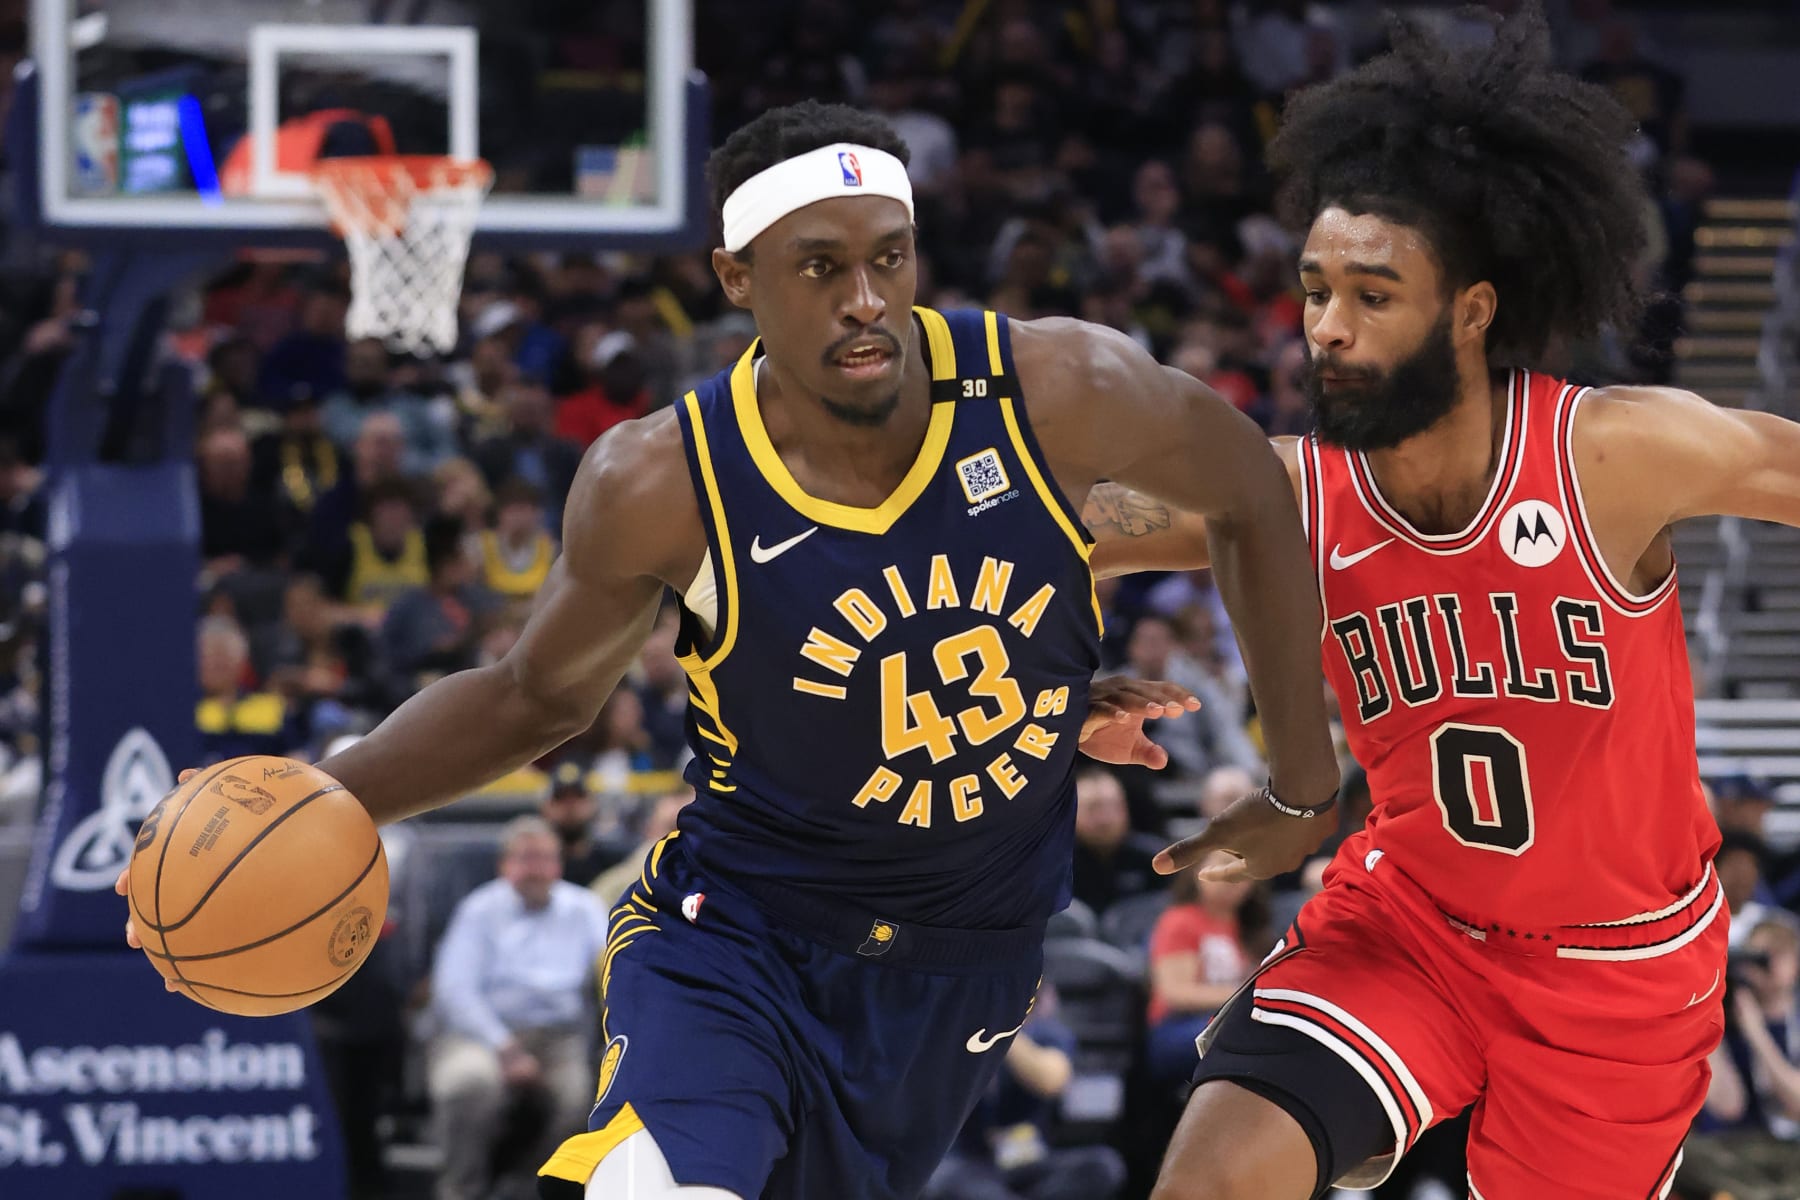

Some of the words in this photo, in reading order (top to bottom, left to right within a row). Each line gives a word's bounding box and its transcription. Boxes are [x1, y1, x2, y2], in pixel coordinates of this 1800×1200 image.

[962, 379, 987, 398] 30
[967, 489, 1020, 517] spokenote
[793, 554, 1056, 700] INDIANA
[1330, 592, 1615, 725] BULLS
[851, 686, 1070, 829] PACERS
[880, 624, 1027, 765] 43
[1429, 721, 1535, 857] 0
[64, 1102, 318, 1164] Vincent
